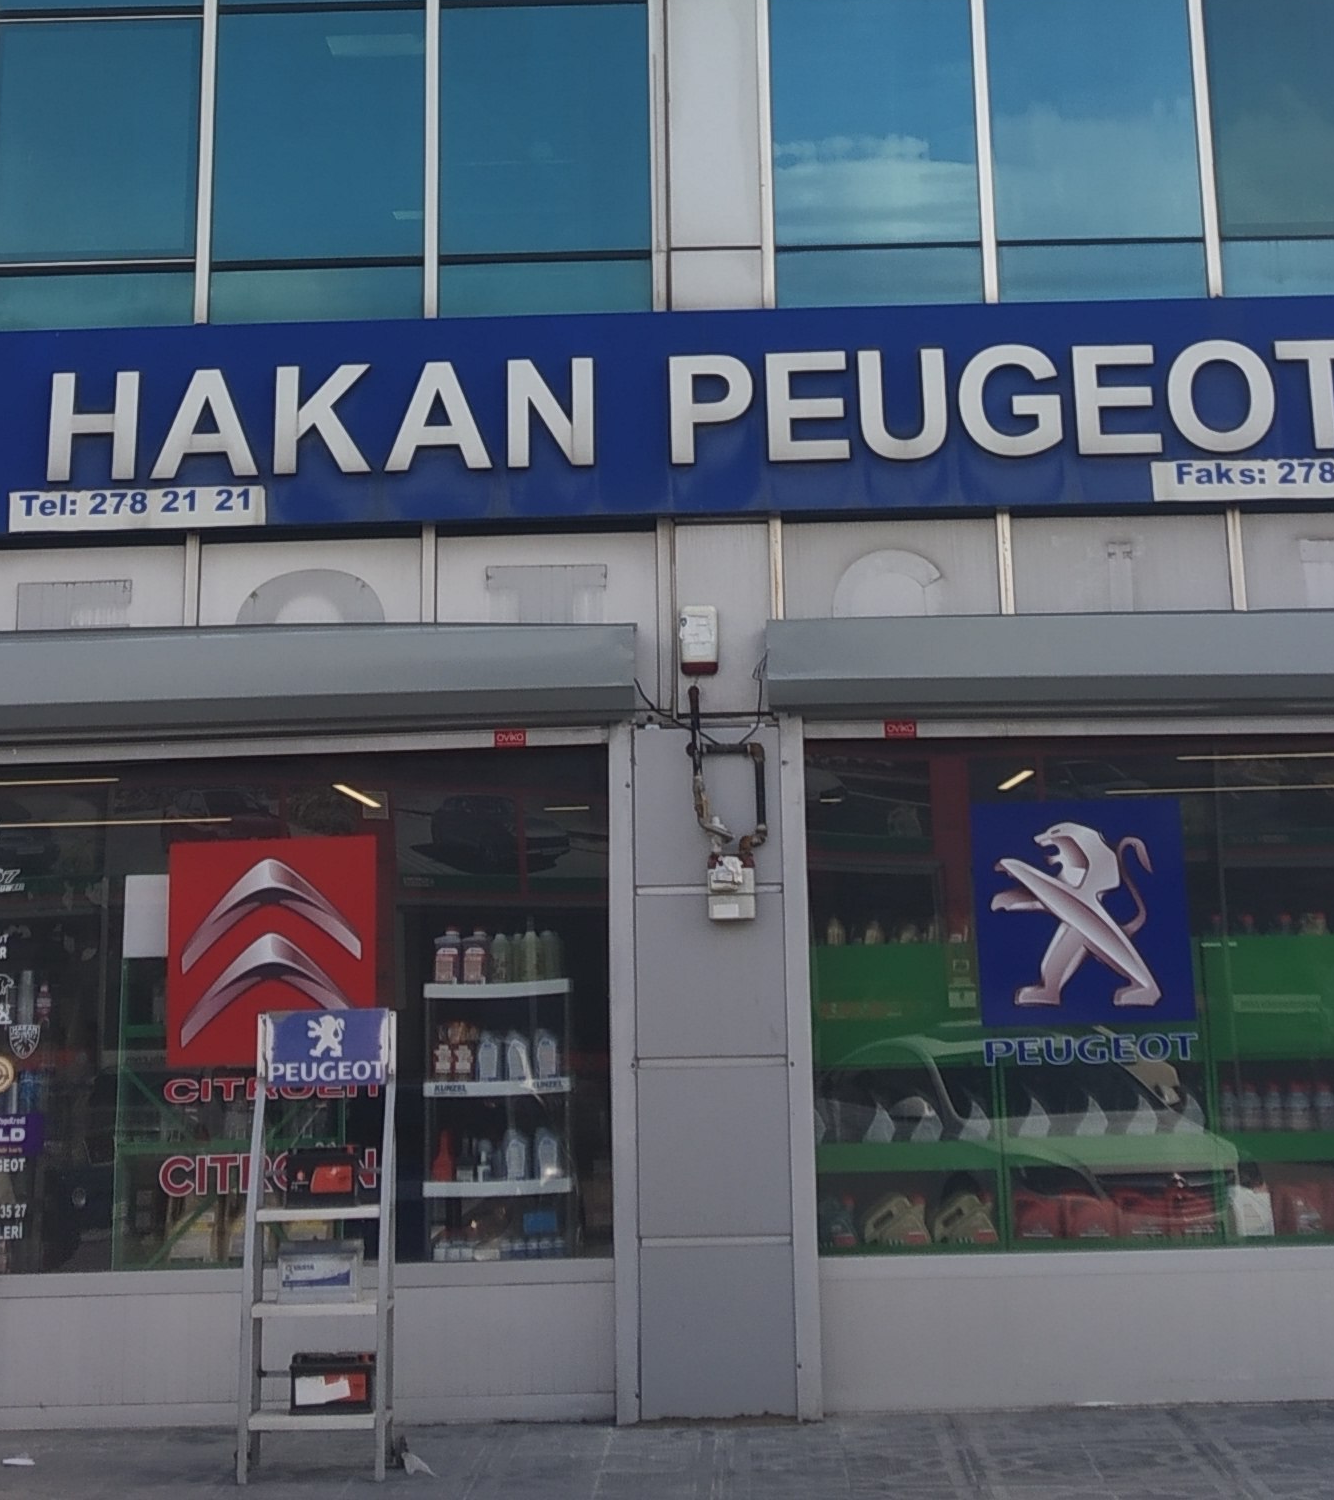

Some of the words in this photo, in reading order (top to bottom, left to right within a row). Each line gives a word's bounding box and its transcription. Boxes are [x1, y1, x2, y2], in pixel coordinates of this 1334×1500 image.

[47, 356, 595, 482] HAKAN
[1175, 461, 1266, 486] Faks:
[19, 493, 77, 518] Tel:
[90, 491, 147, 516] 278
[162, 489, 197, 513] 21
[214, 487, 251, 512] 21
[983, 1031, 1198, 1067] PEUGEOT
[269, 1060, 383, 1083] PEUGEOT
[0, 1204, 12, 1218] 35
[14, 1203, 27, 1218] 27
